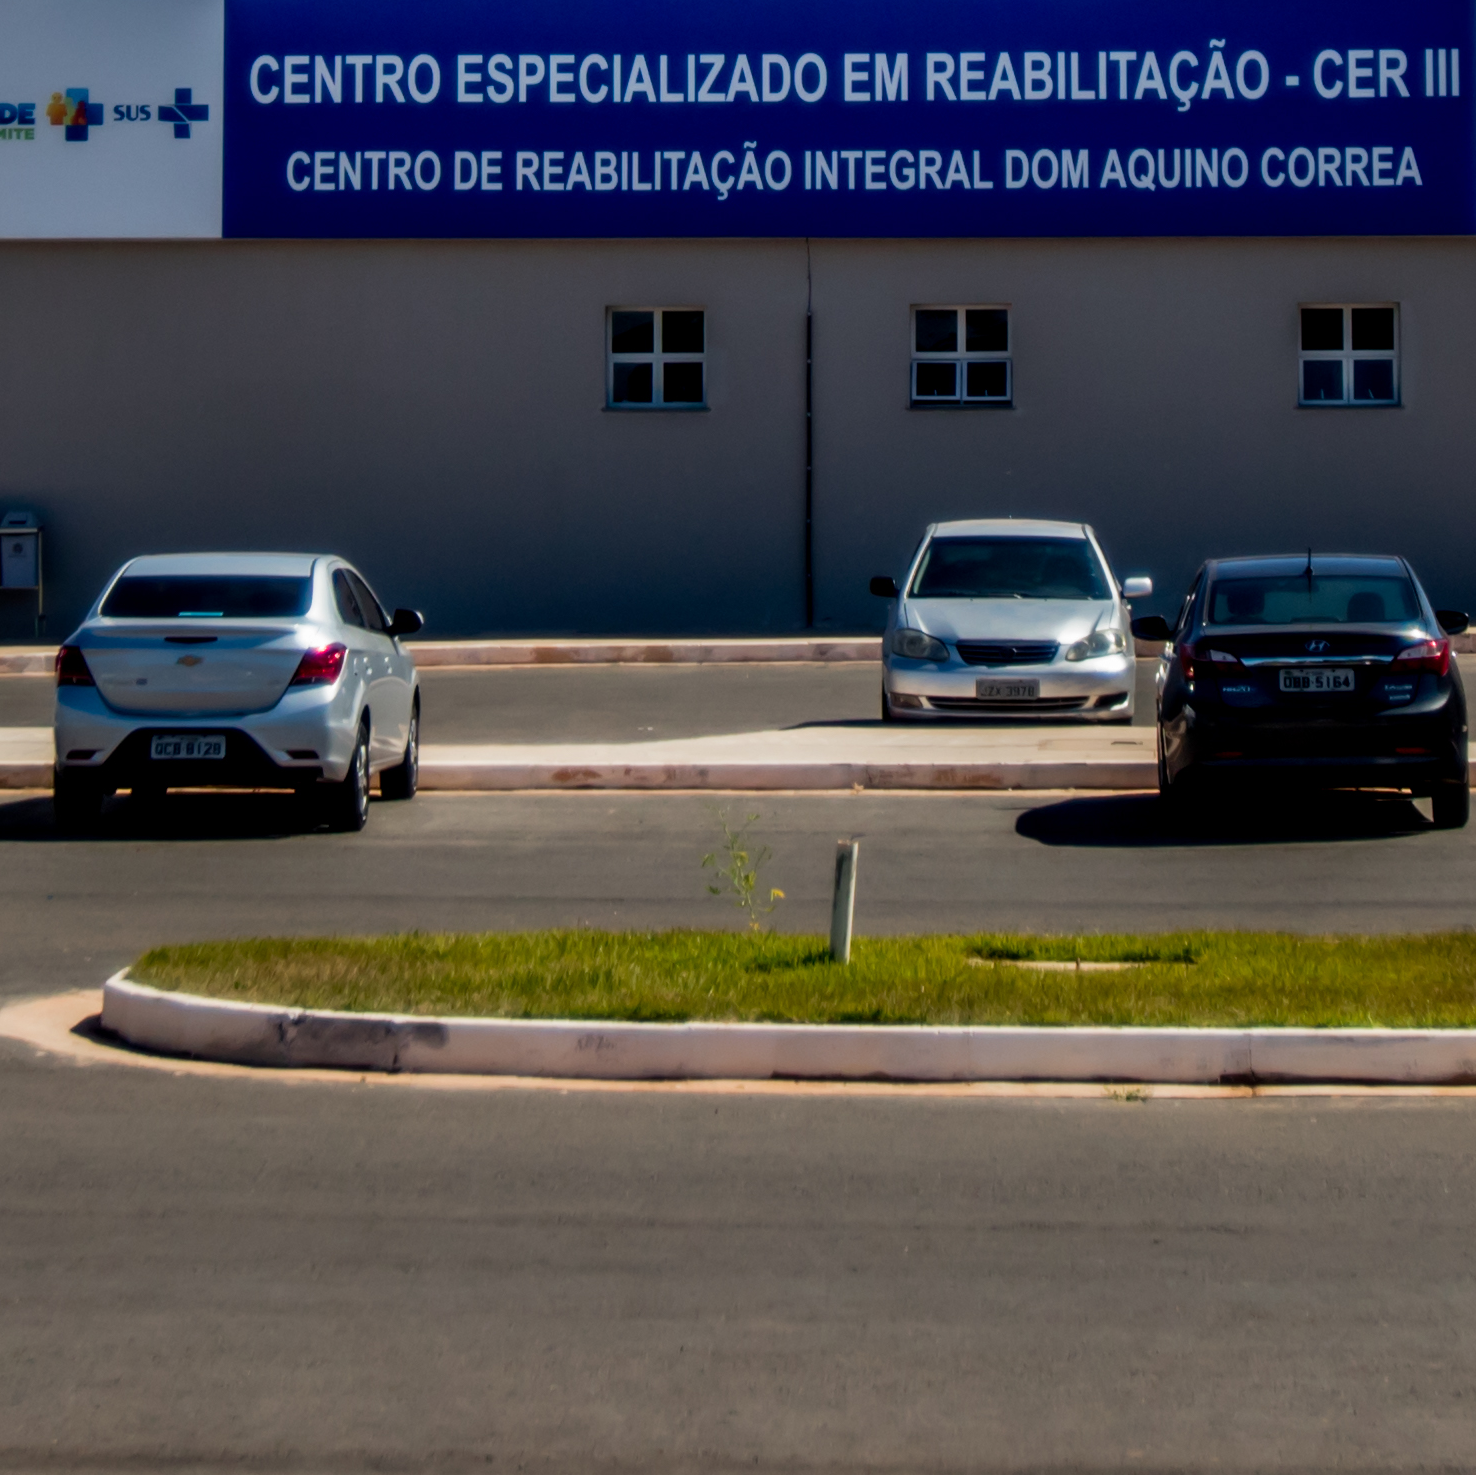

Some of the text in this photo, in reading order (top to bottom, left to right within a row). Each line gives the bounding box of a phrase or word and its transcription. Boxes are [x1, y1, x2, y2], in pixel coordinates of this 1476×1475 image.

[250, 39, 1460, 112] CENTRO ESPECIALIZADO EM REABILITAÇÃO - CER III
[113, 104, 152, 122] SUS
[286, 142, 1423, 201] CENTRO DE REABILITAÇÃO INTEGRAL DOM AQUINO CORREA
